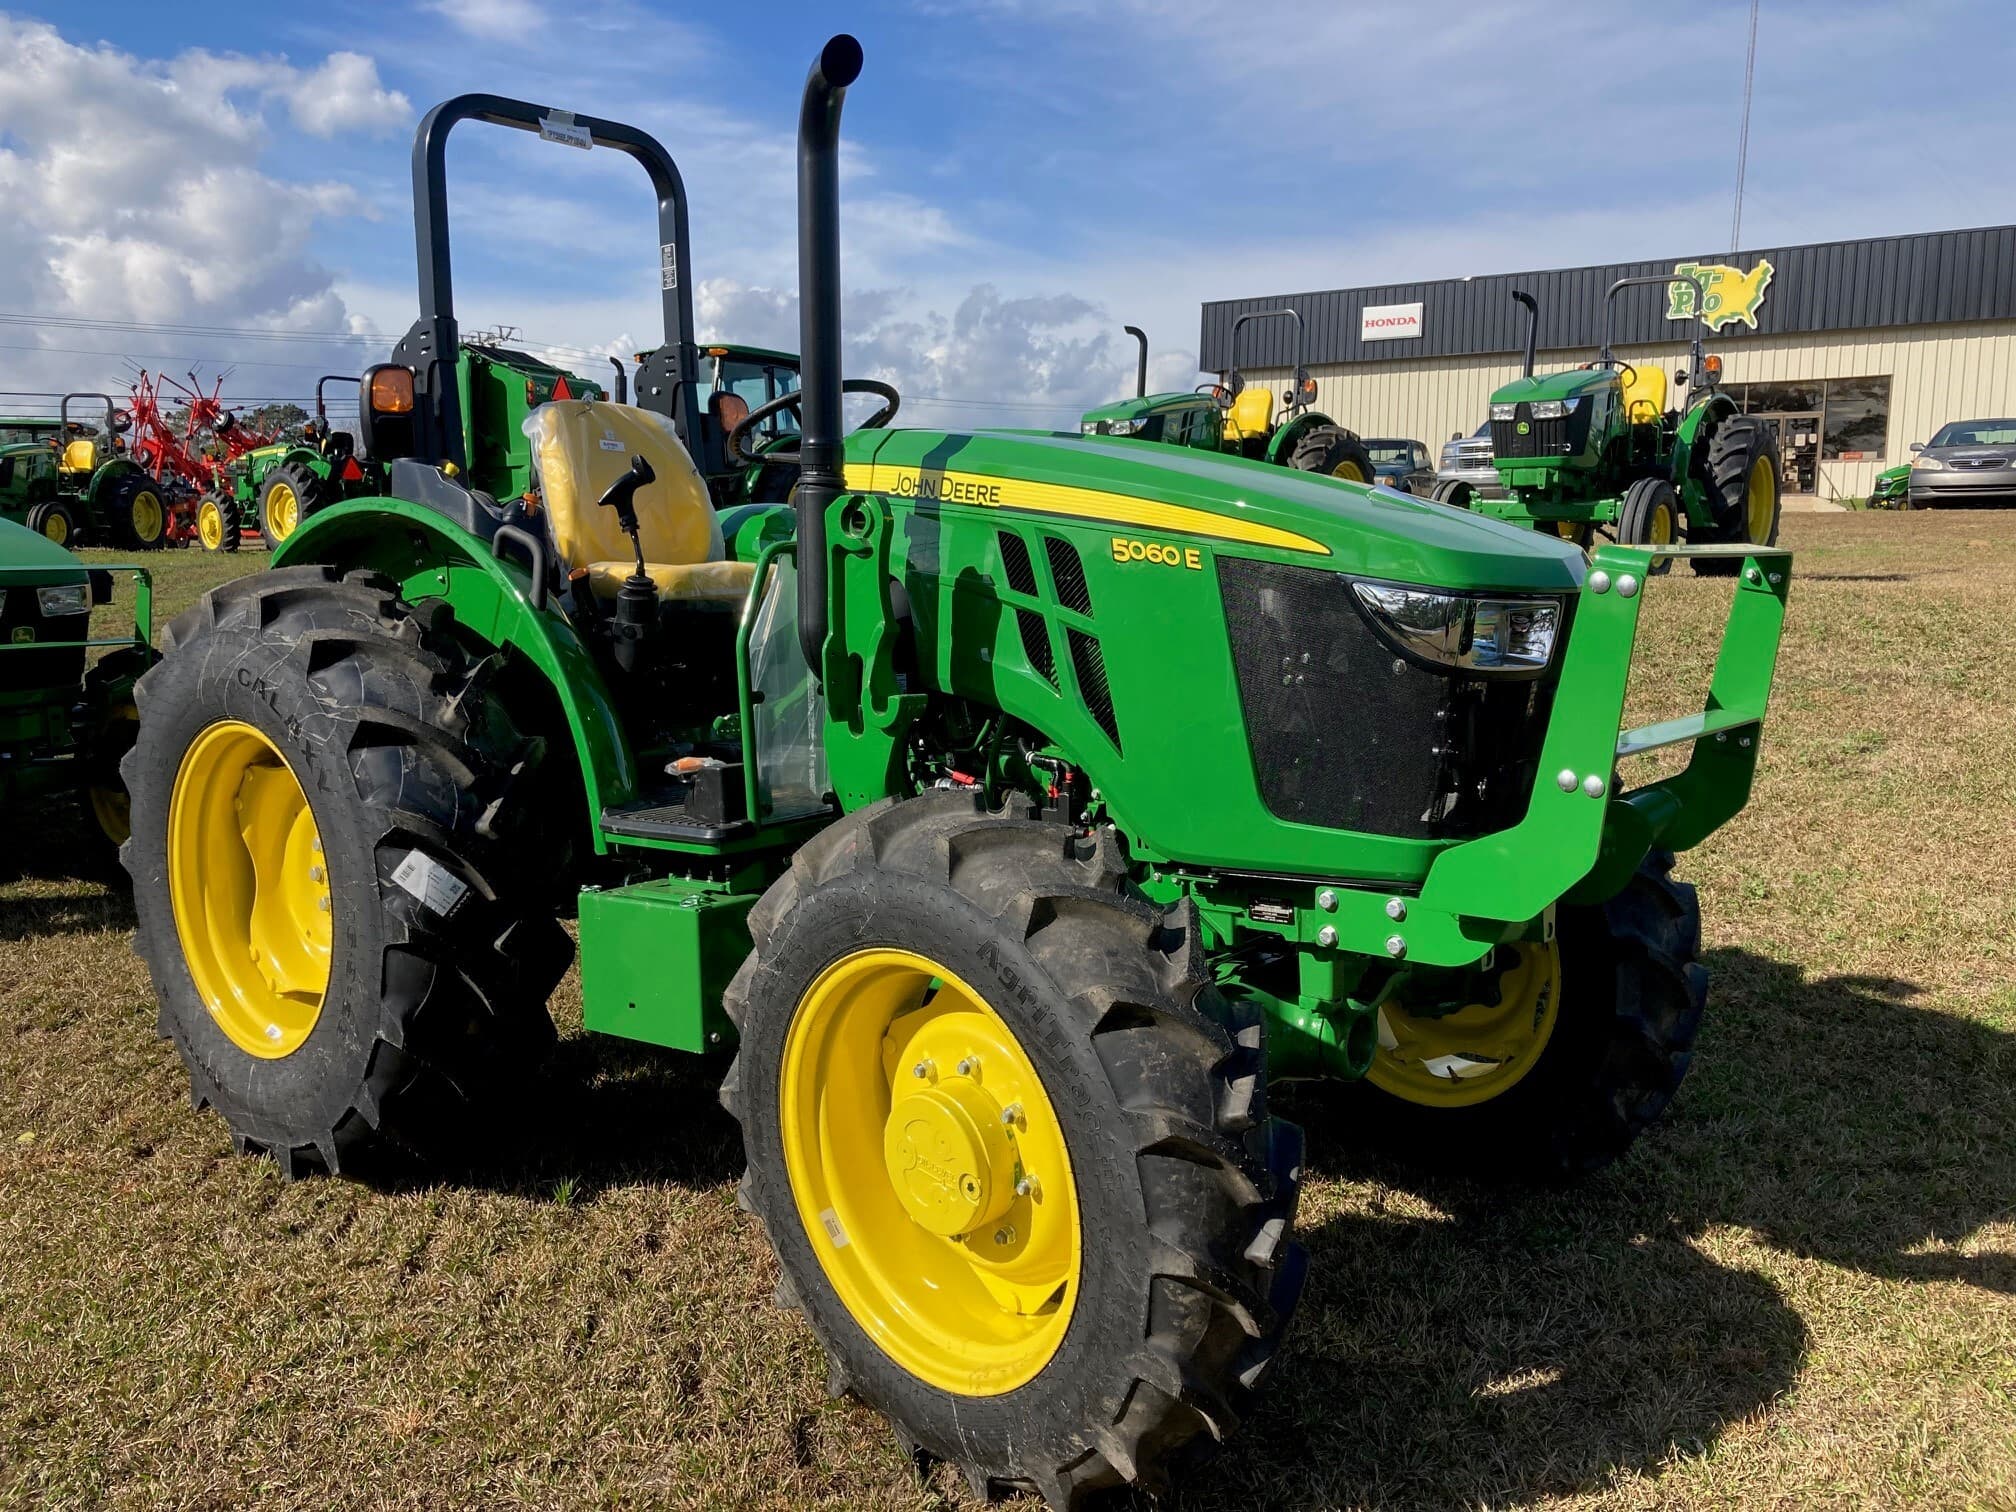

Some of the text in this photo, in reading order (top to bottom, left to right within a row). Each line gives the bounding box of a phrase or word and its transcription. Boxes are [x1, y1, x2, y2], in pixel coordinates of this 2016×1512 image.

[1672, 291, 1722, 316] Po
[1364, 316, 1417, 328] HONDA
[891, 471, 1001, 504] JOHN DEERE
[1111, 537, 1203, 571] 5060 E
